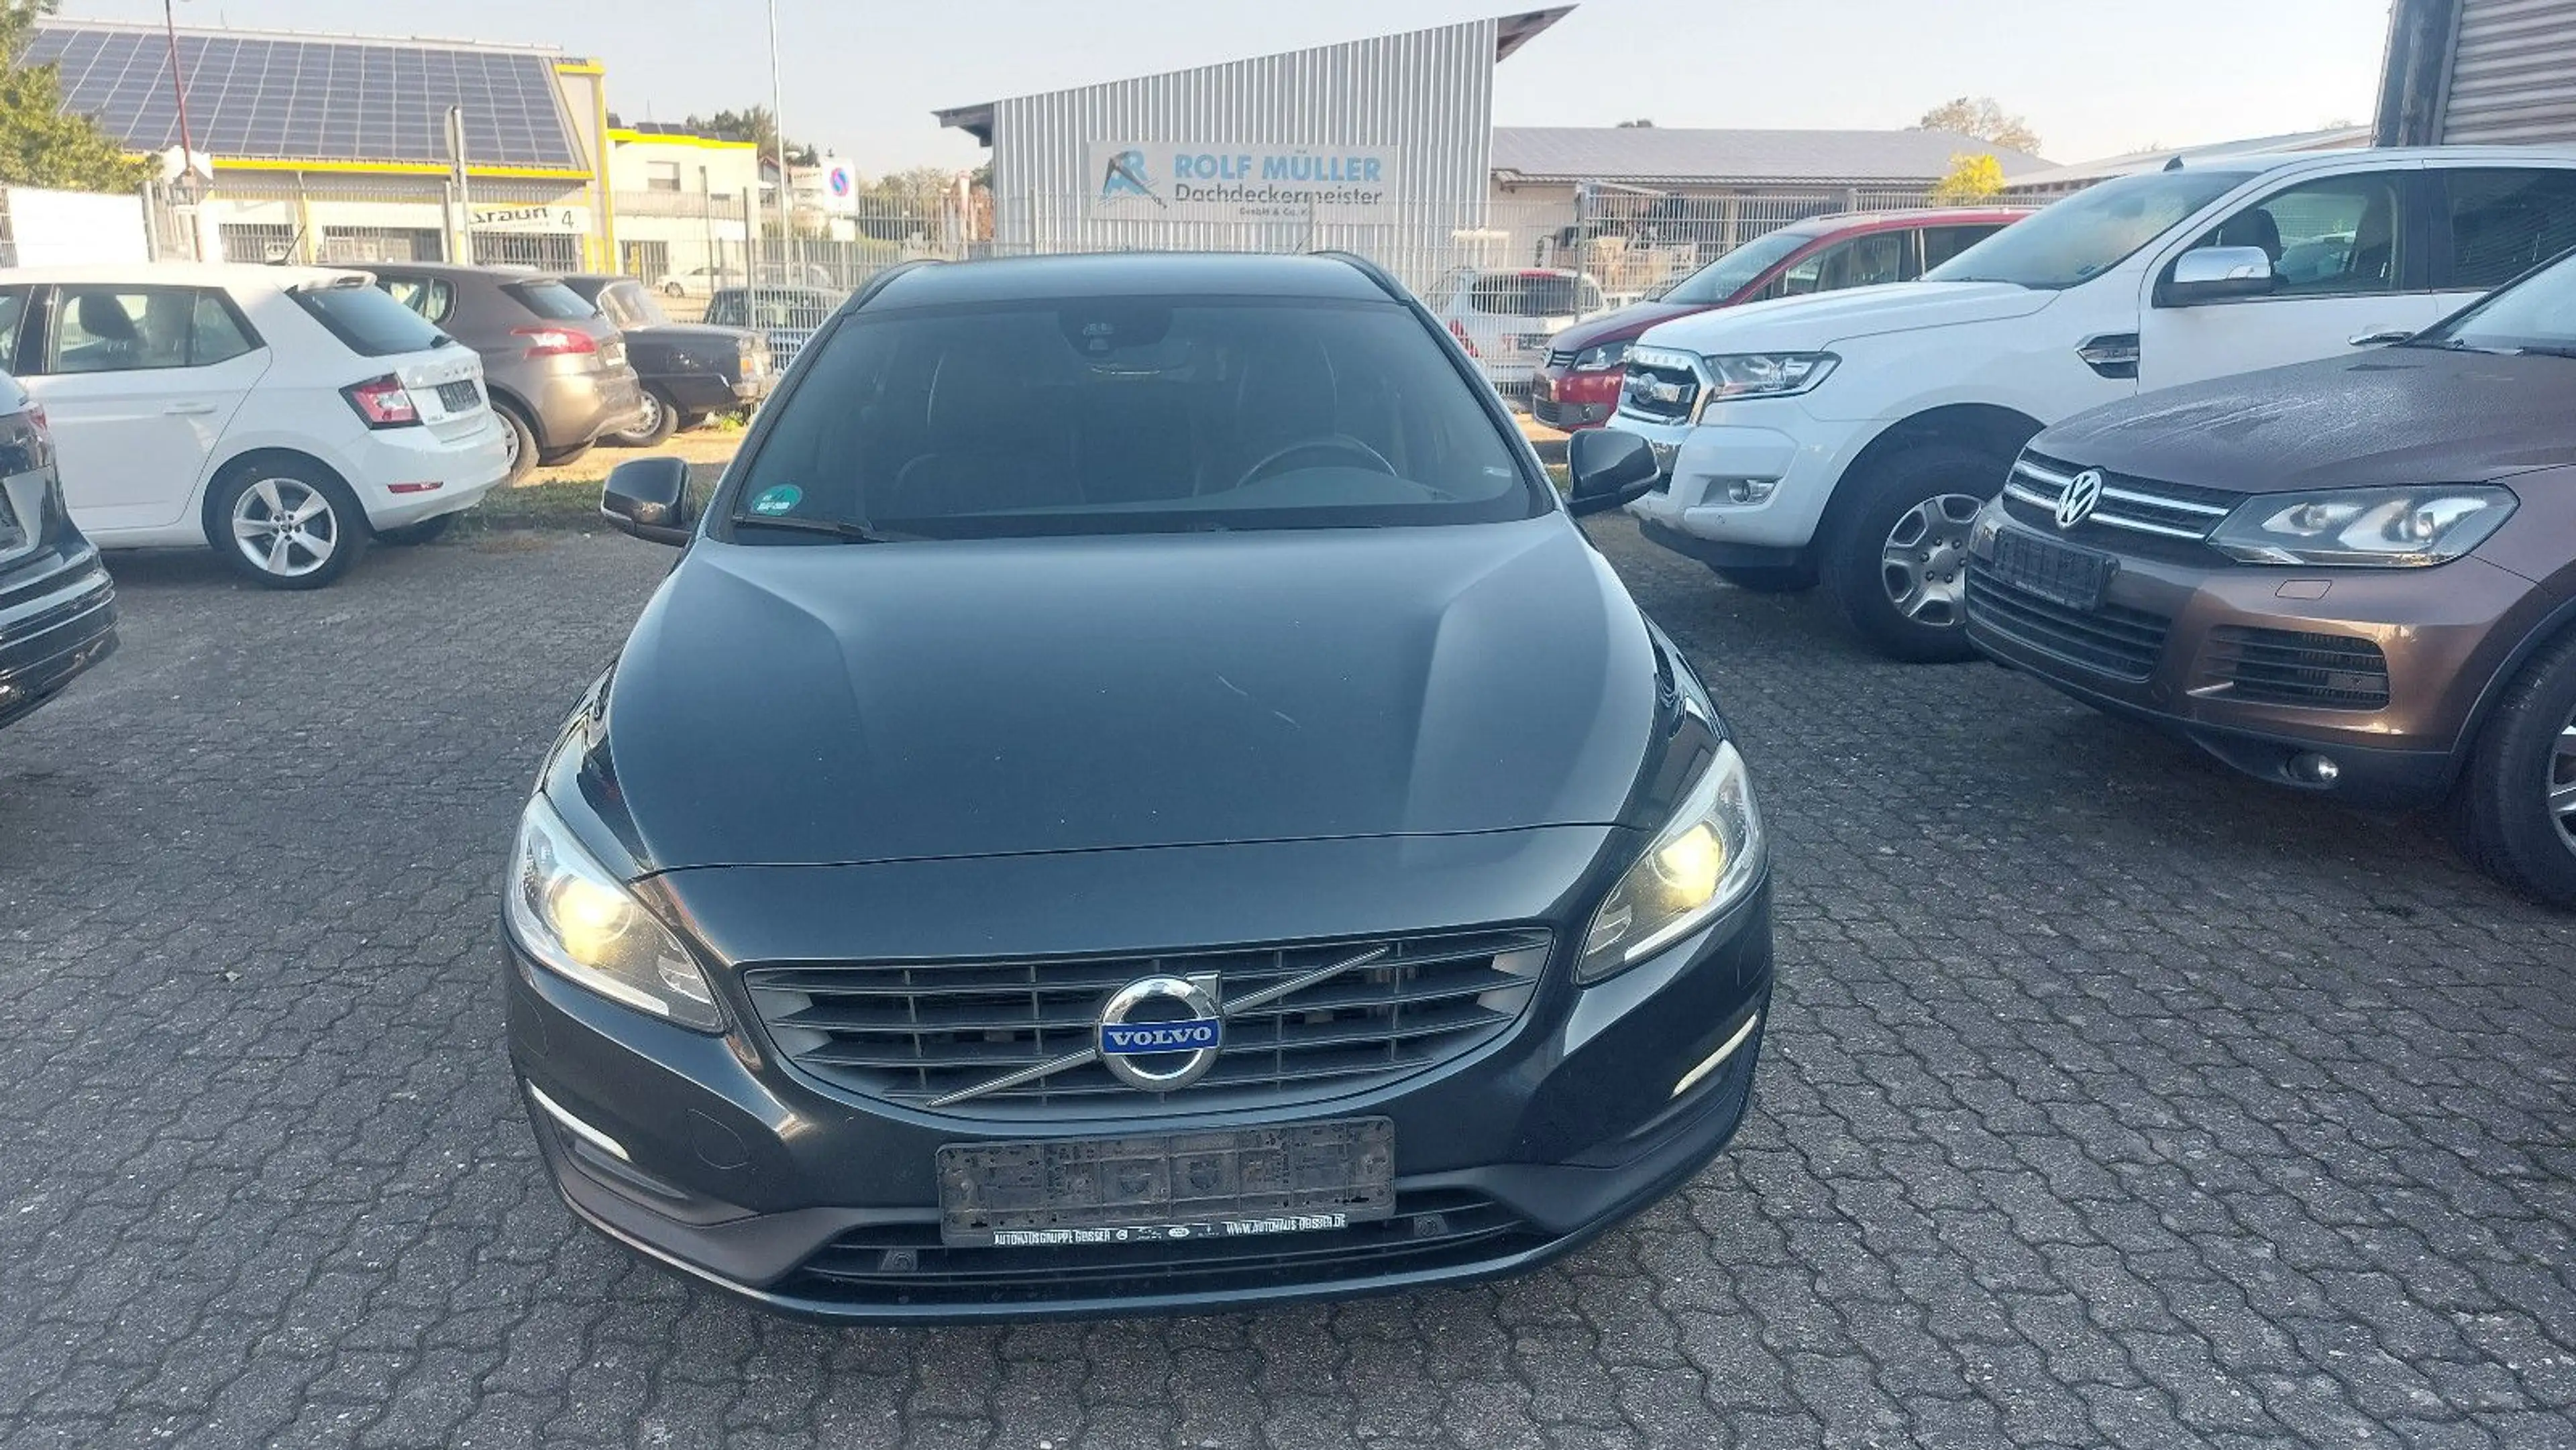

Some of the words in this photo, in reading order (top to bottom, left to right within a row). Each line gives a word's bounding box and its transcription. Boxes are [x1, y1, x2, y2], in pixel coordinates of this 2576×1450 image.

[1175, 154, 1252, 179] ROLF
[1262, 150, 1381, 182] MÜLLER
[1175, 182, 1383, 205] Dachdeckermeister
[1108, 1027, 1212, 1046] VOLVO
